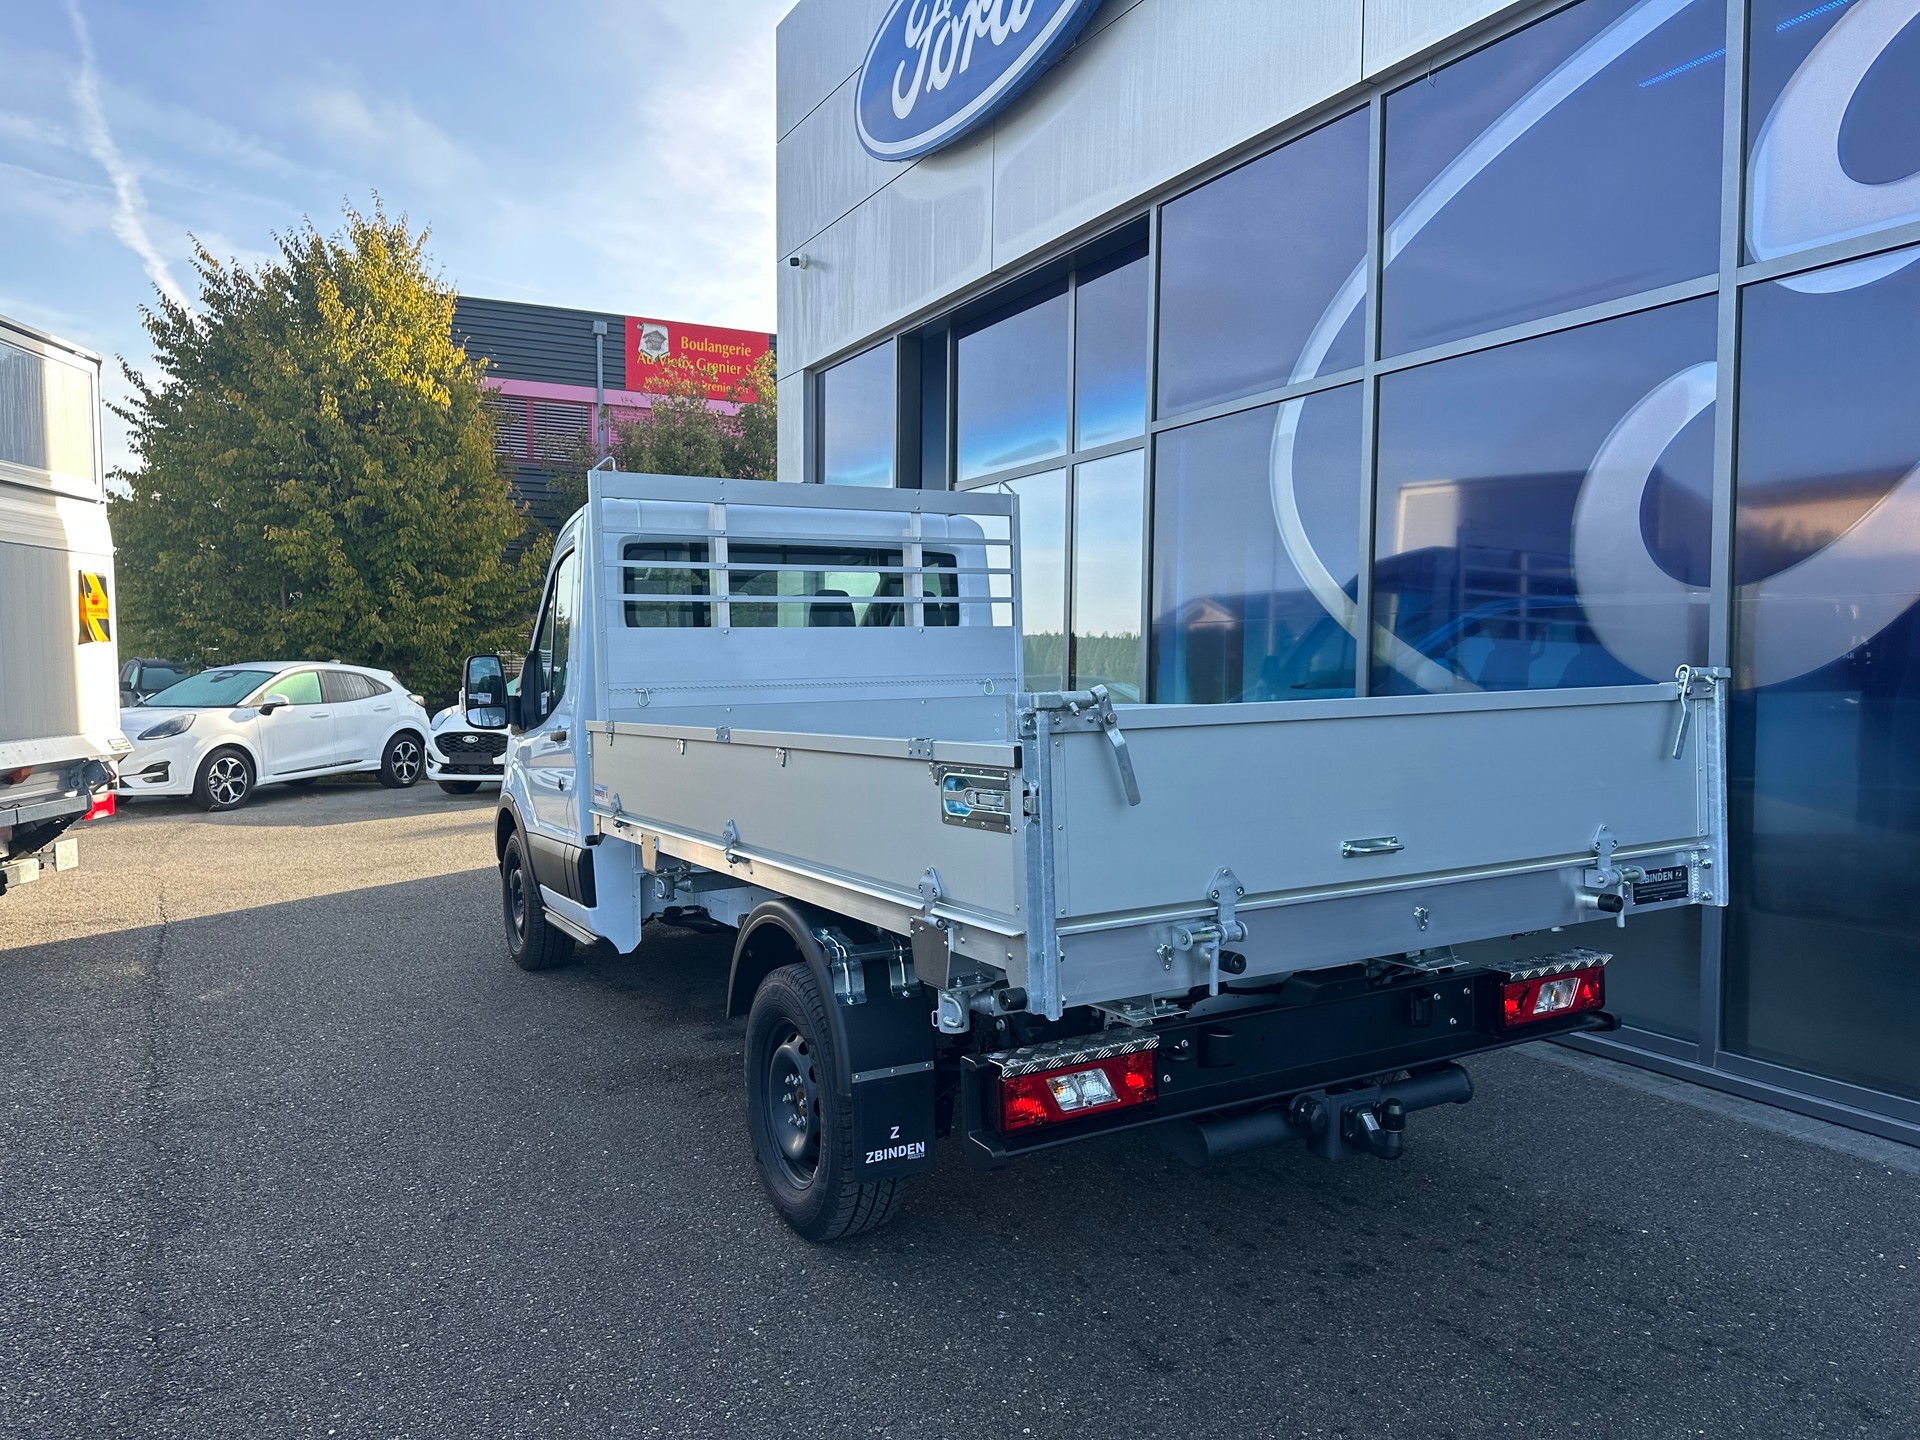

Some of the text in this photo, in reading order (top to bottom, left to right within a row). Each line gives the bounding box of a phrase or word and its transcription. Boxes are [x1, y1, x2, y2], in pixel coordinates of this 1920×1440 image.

[680, 336, 752, 358] Boulangerie
[636, 352, 654, 365] Au
[696, 357, 742, 375] Grenier
[1640, 871, 1673, 885] BINDEN
[890, 1125, 900, 1139] Z
[865, 1141, 925, 1164] ZBINDEN
